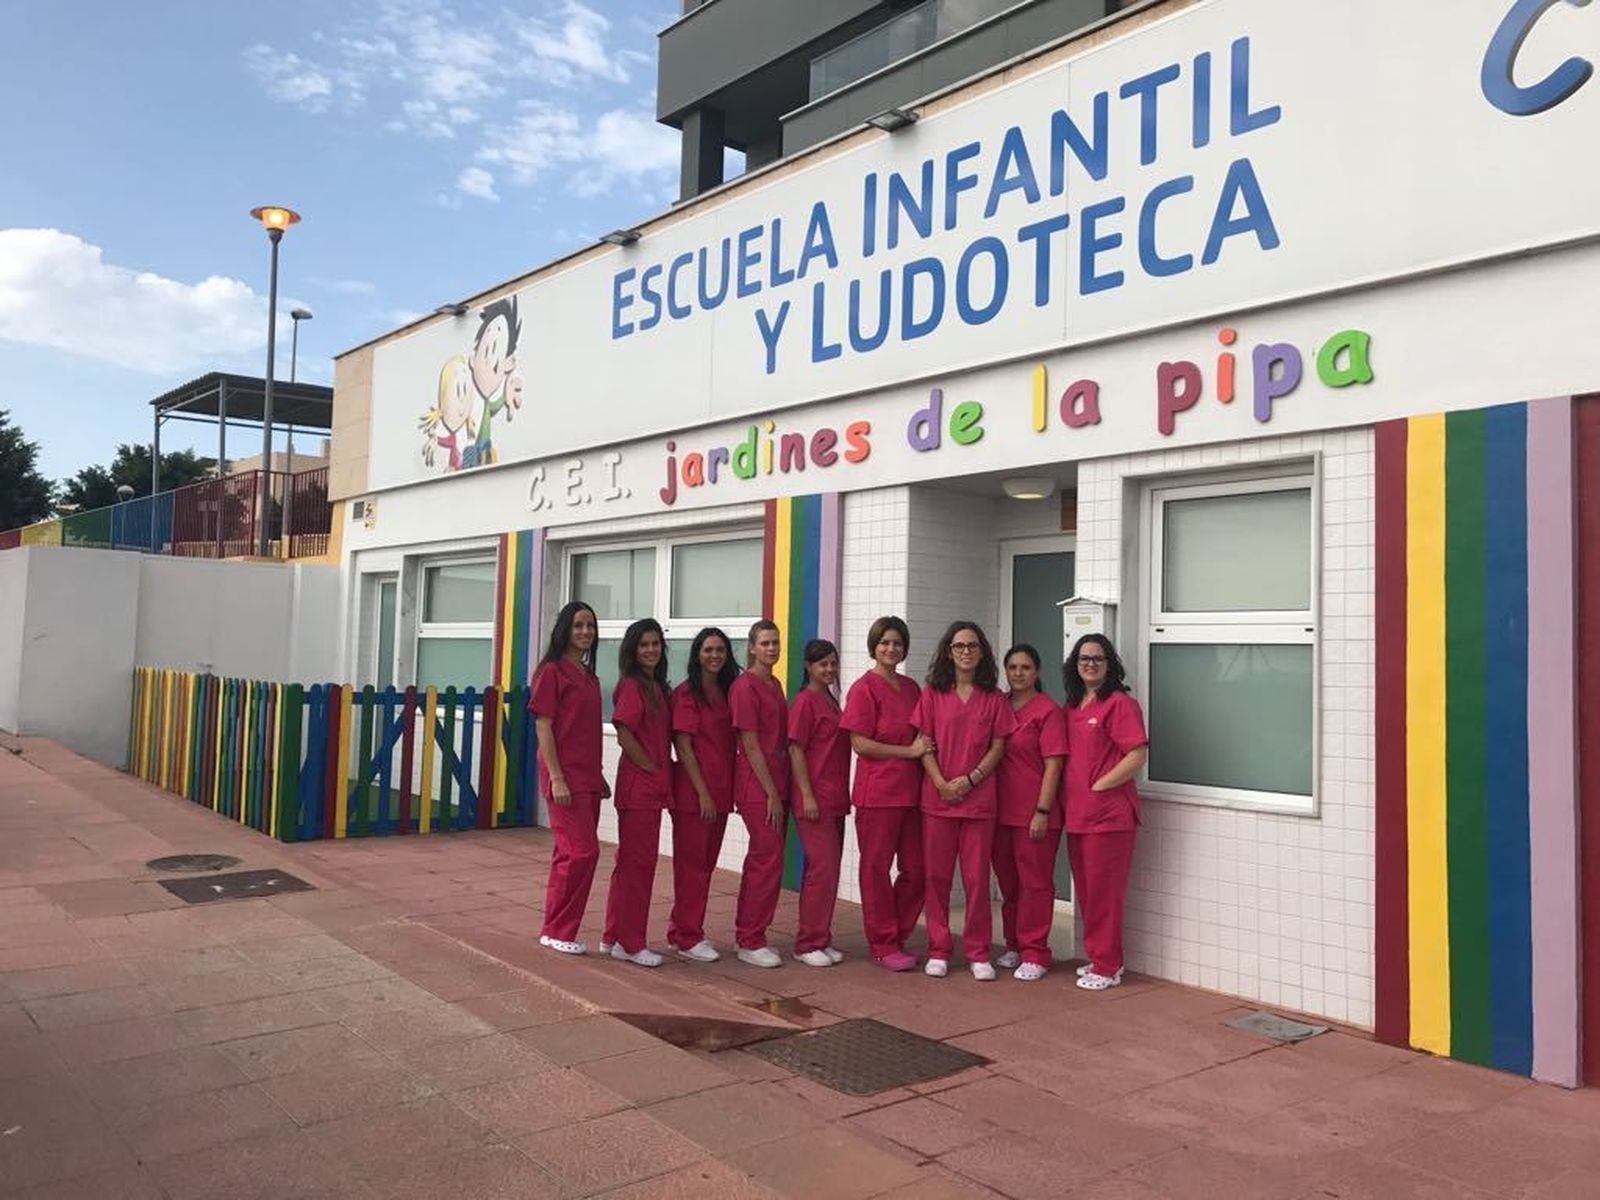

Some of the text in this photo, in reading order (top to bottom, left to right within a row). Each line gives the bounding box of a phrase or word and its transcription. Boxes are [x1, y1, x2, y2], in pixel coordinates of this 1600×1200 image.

[612, 35, 1281, 339] ESCUELA INFANTIL
[755, 157, 1280, 374] Y LUDOTECA
[660, 420, 871, 505] jardines
[907, 388, 985, 452] de
[1031, 362, 1102, 434] la
[1157, 327, 1375, 437] pipa
